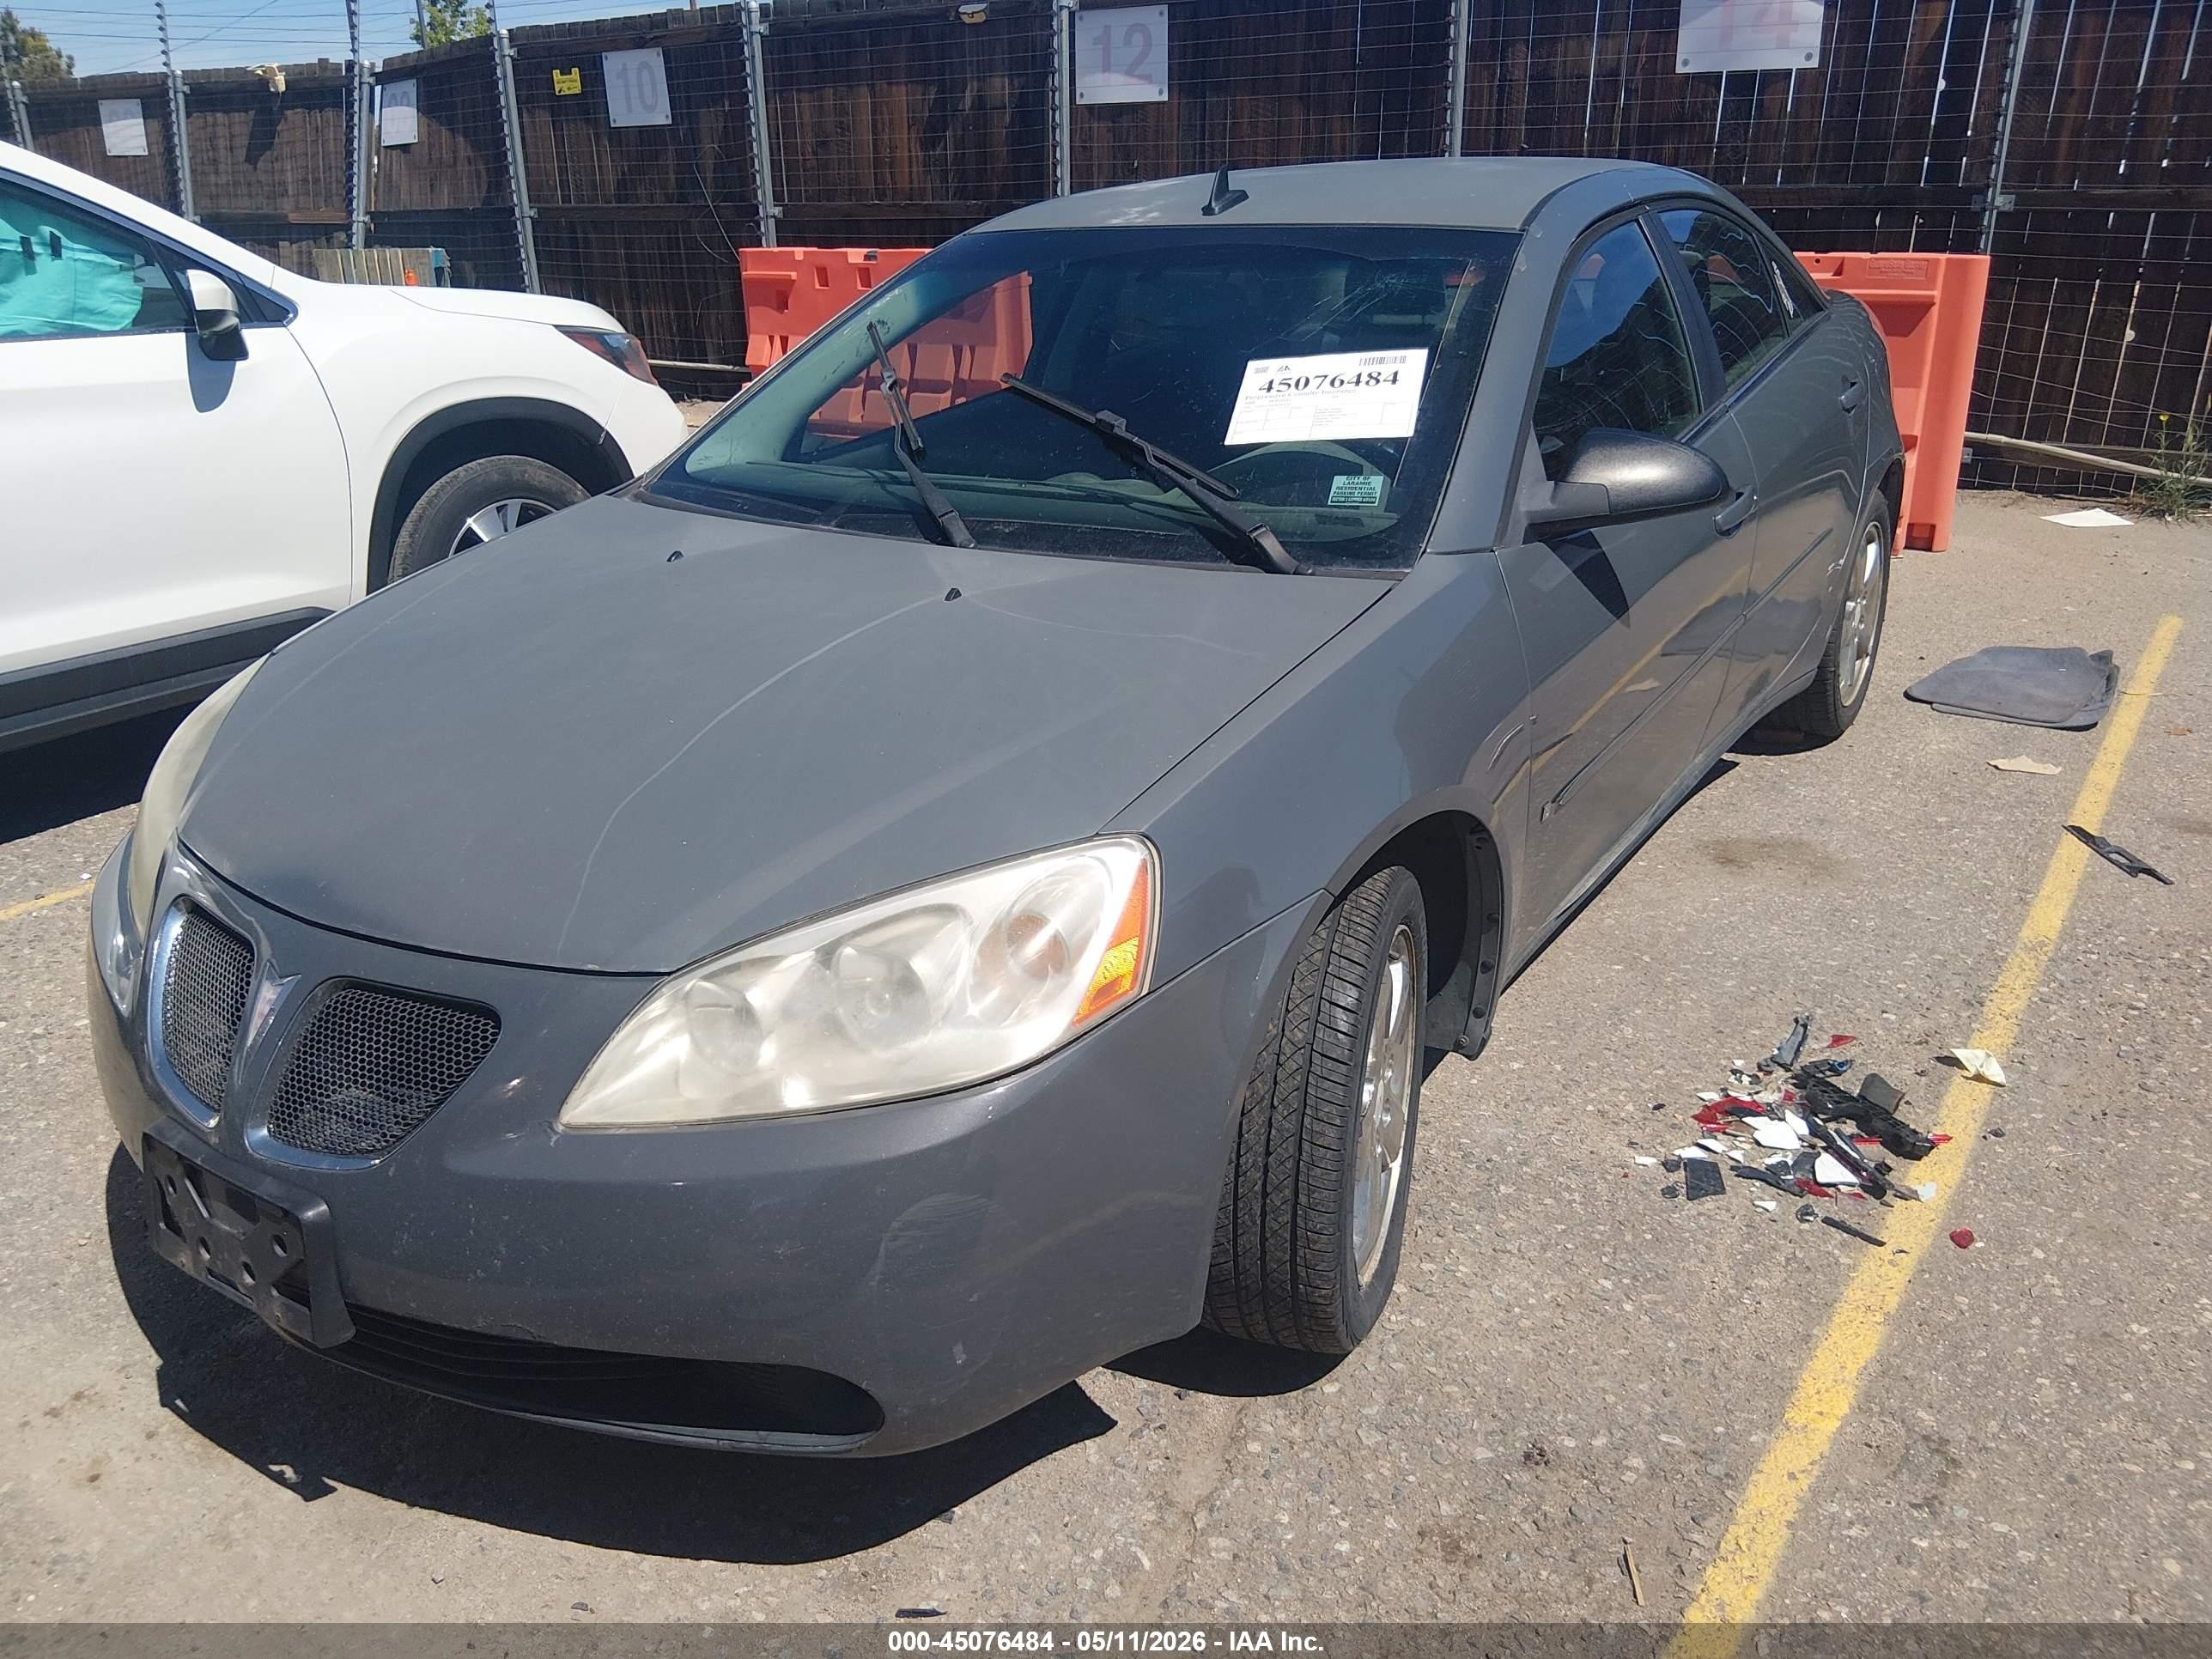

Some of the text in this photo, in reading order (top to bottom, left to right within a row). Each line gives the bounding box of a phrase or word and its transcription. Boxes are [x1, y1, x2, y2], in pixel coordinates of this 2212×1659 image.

[1091, 22, 1153, 85] 12
[616, 61, 659, 113] 10
[1258, 369, 1400, 393] 45076484
